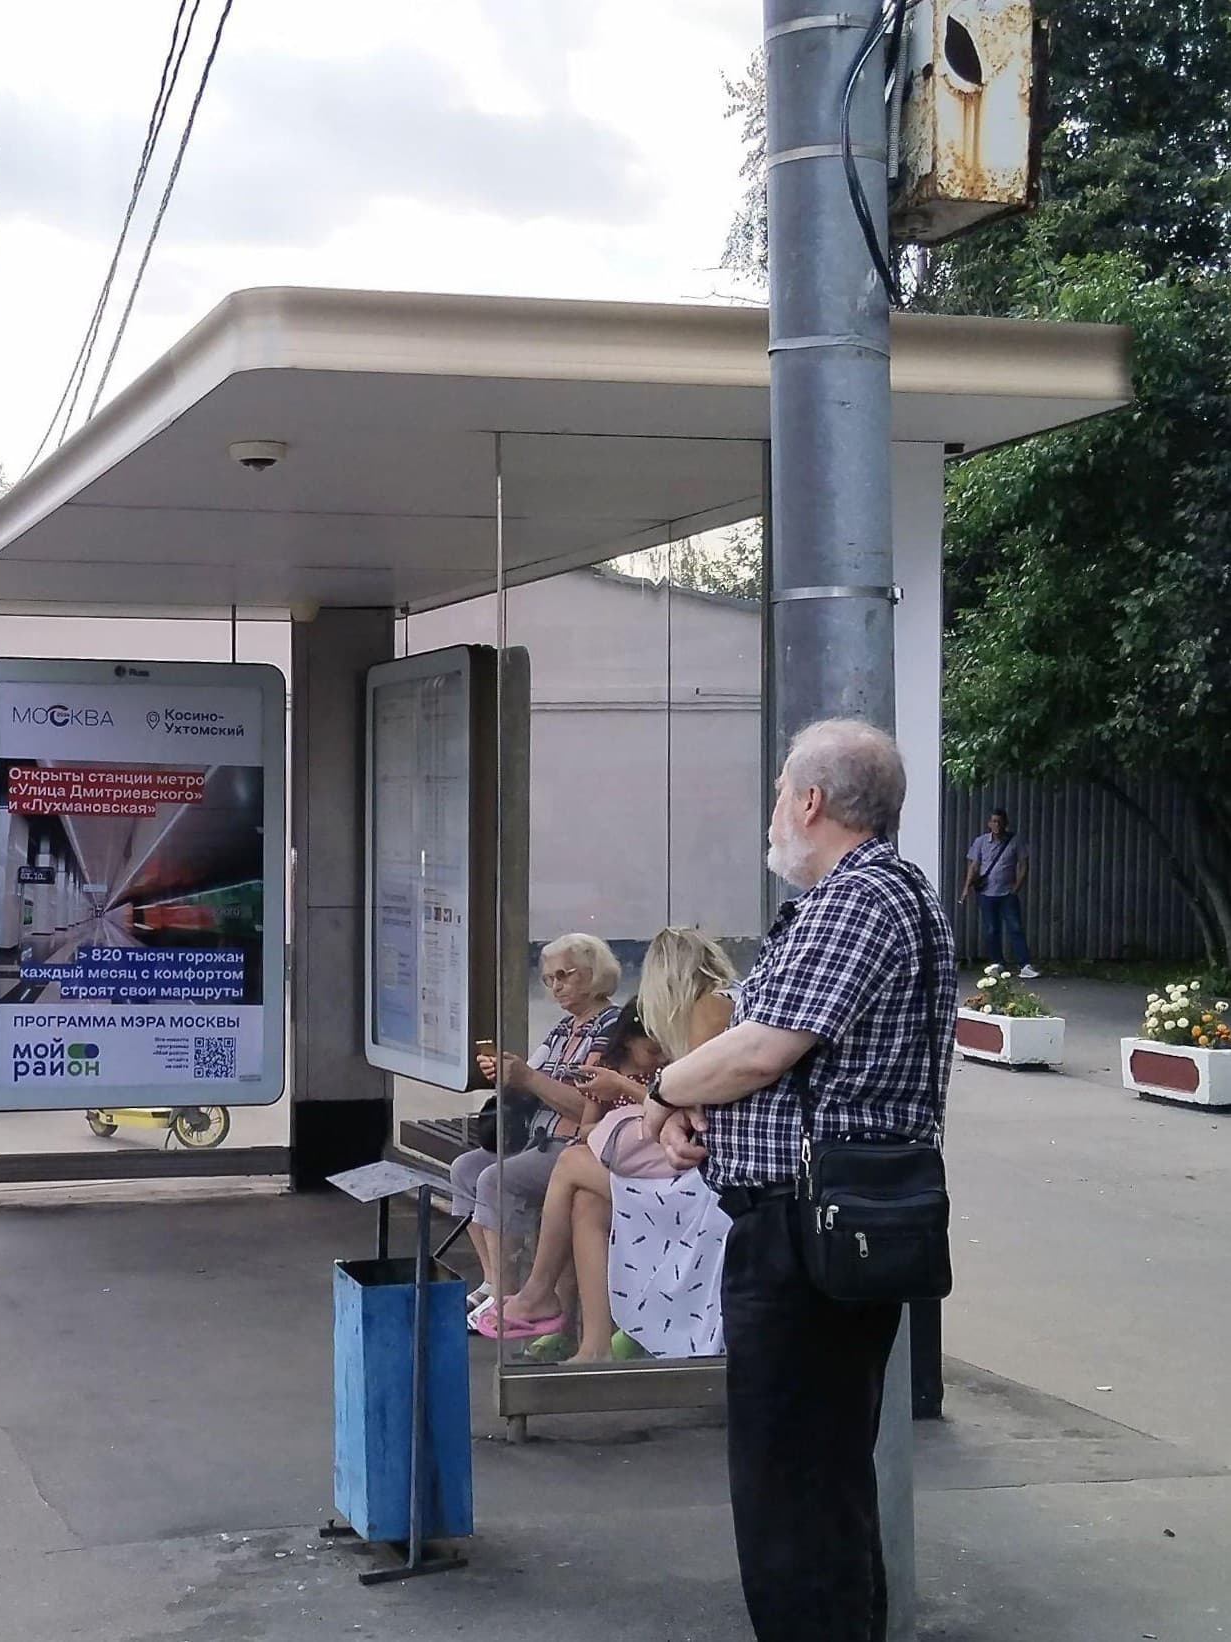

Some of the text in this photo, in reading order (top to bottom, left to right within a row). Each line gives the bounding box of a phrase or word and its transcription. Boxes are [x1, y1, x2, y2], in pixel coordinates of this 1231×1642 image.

[12, 705, 114, 727] МОСКВА
[164, 708, 224, 722] Косино-
[165, 722, 244, 737] Ухтомский
[9, 767, 205, 788] Открыты станции метро
[9, 783, 203, 800] «Улица Дмитриевского»
[8, 800, 156, 814] и «Лухмановская»
[91, 949, 122, 962] 820
[126, 951, 176, 962] тысяч
[178, 952, 244, 965] горожан
[20, 966, 244, 982] каждый месяц с комфортом
[60, 986, 243, 999] строят свои маршруты
[13, 1015, 240, 1029] ПРОГРАММА МЭРА МОСКВЫ
